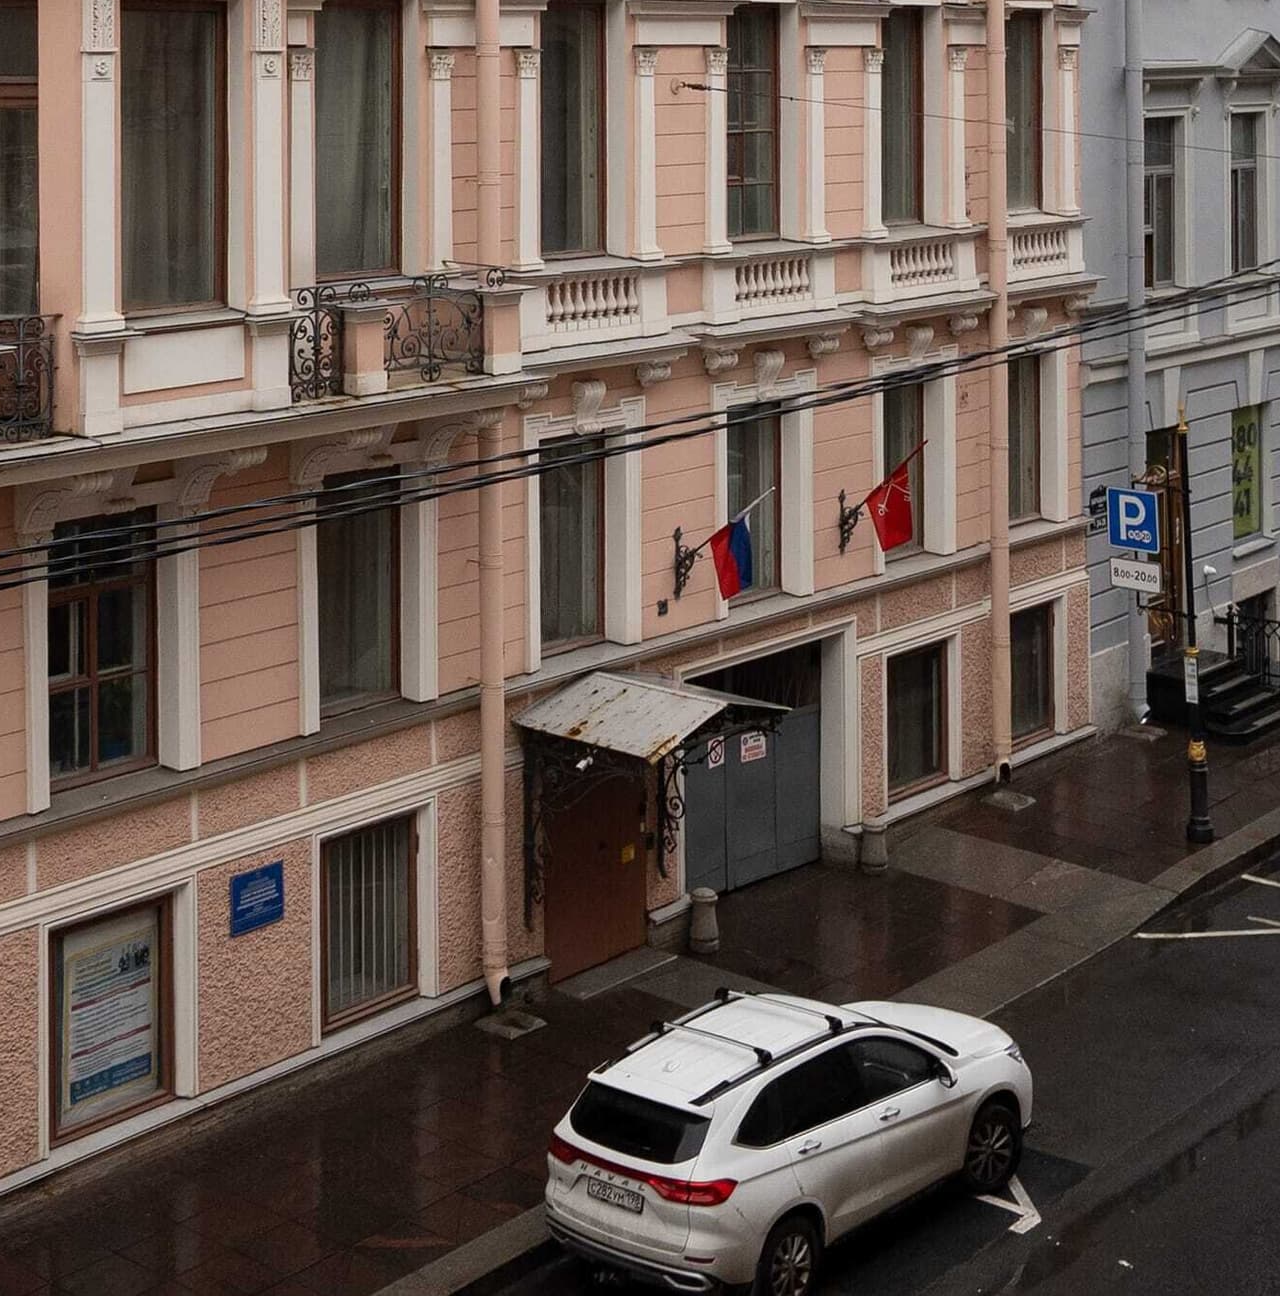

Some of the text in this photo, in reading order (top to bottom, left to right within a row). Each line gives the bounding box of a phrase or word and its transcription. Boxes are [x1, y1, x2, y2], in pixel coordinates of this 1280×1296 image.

[1232, 422, 1257, 453] 80
[1119, 494, 1146, 540] P
[580, 1163, 645, 1191] HAVAL
